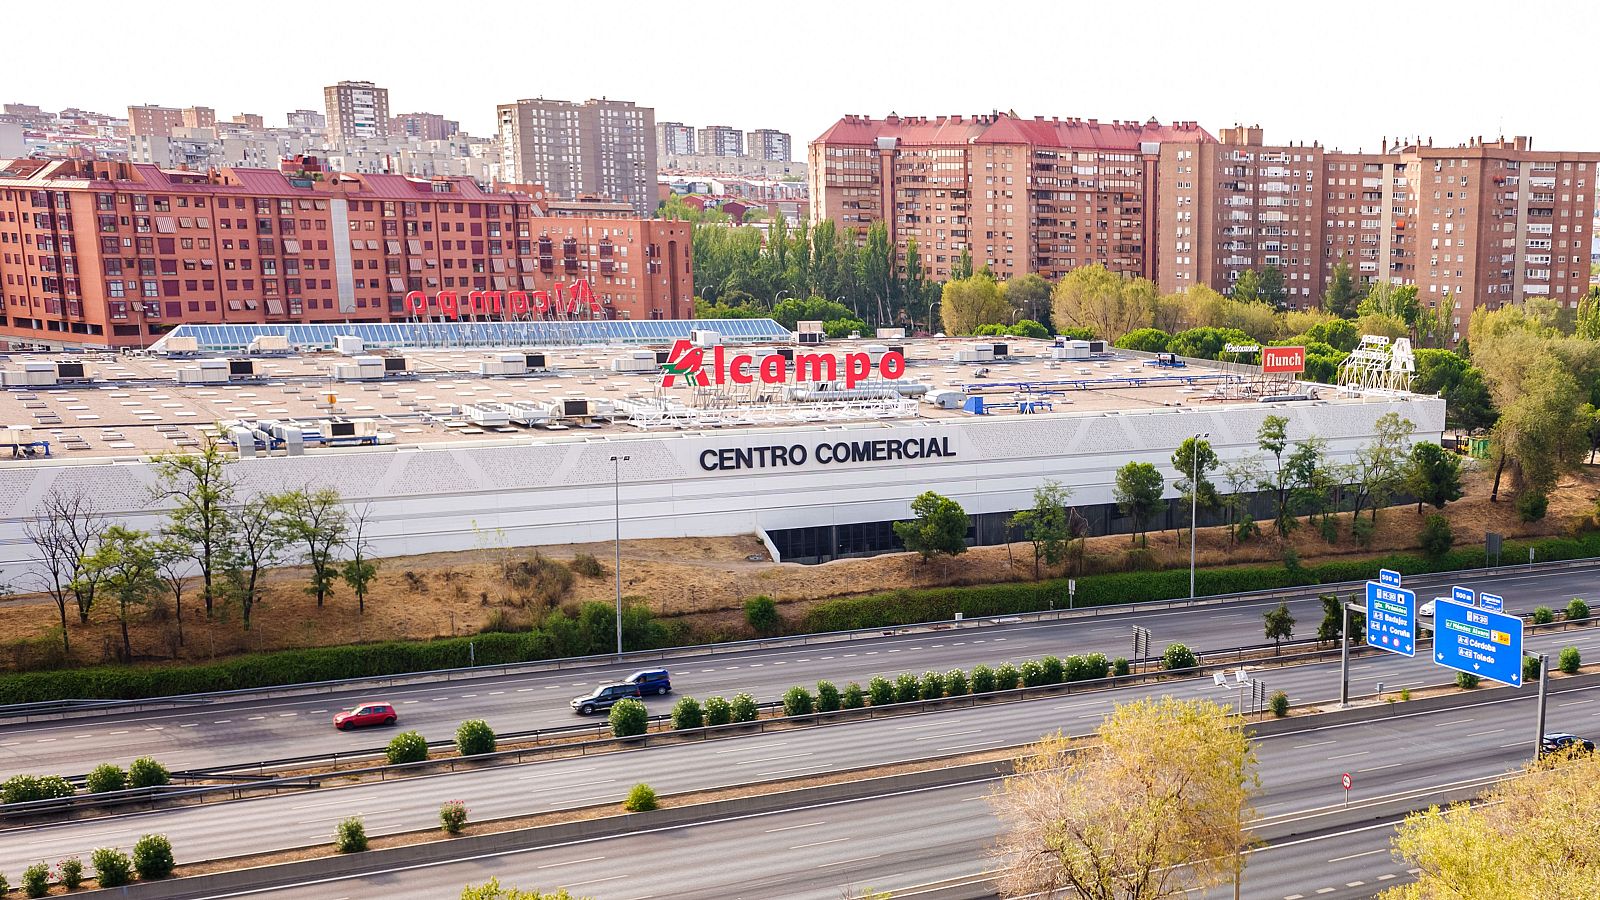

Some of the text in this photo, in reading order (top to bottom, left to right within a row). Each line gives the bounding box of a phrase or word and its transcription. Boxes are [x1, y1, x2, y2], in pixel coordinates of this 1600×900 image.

[662, 339, 905, 389] Alcampo
[1266, 352, 1301, 367] flunch
[700, 437, 956, 471] CENTRO COMERCIAL
[1384, 613, 1408, 626] Badajoz
[1382, 624, 1387, 632] A
[1390, 626, 1411, 638] Coruña
[1469, 638, 1497, 652] Córdoba
[1472, 651, 1495, 664] Toledo
